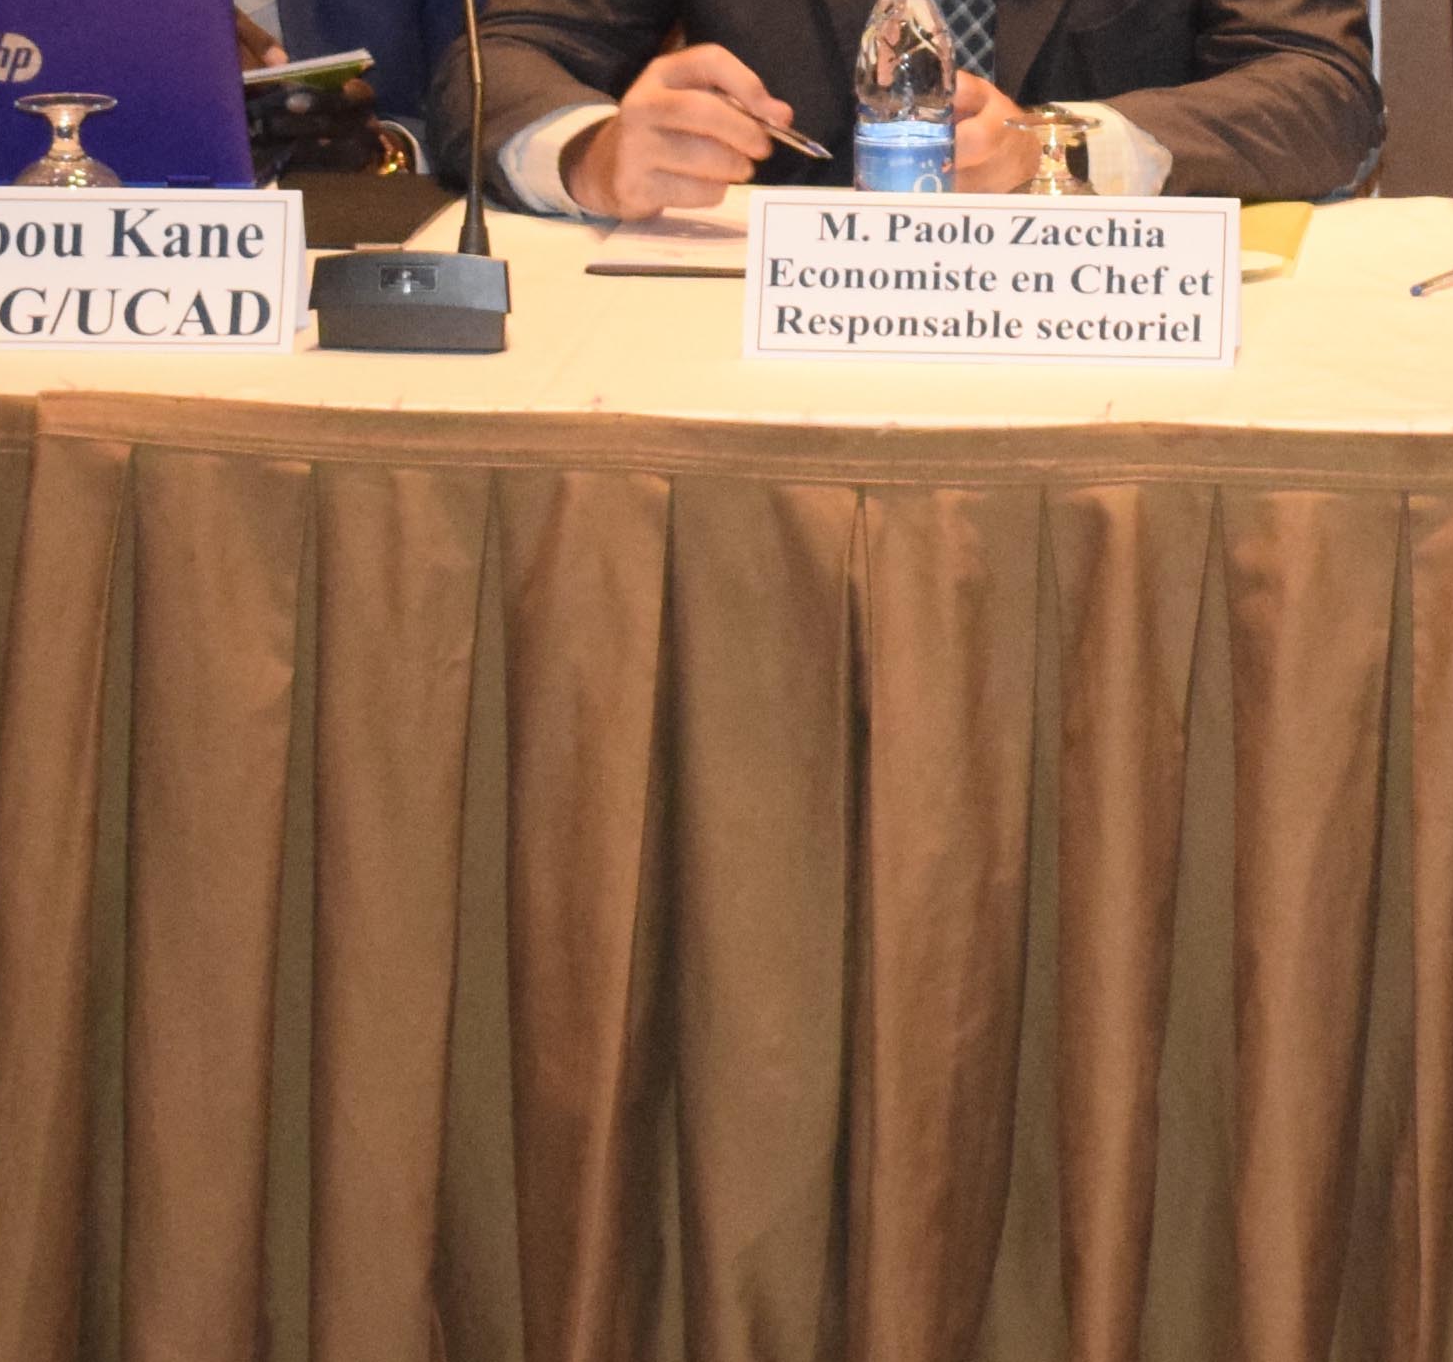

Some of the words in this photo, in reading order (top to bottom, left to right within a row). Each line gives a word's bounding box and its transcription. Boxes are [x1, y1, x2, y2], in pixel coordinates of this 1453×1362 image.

[110, 207, 265, 260] Kane
[820, 211, 871, 243] M.
[887, 212, 996, 245] Paolo
[1008, 215, 1166, 249] Zacchia
[768, 257, 998, 293] Economiste
[1010, 271, 1055, 294] en
[1069, 263, 1170, 296] Chef
[1177, 270, 1212, 297] et
[775, 304, 1024, 345] Responsable
[1036, 312, 1202, 344] sectoriel
